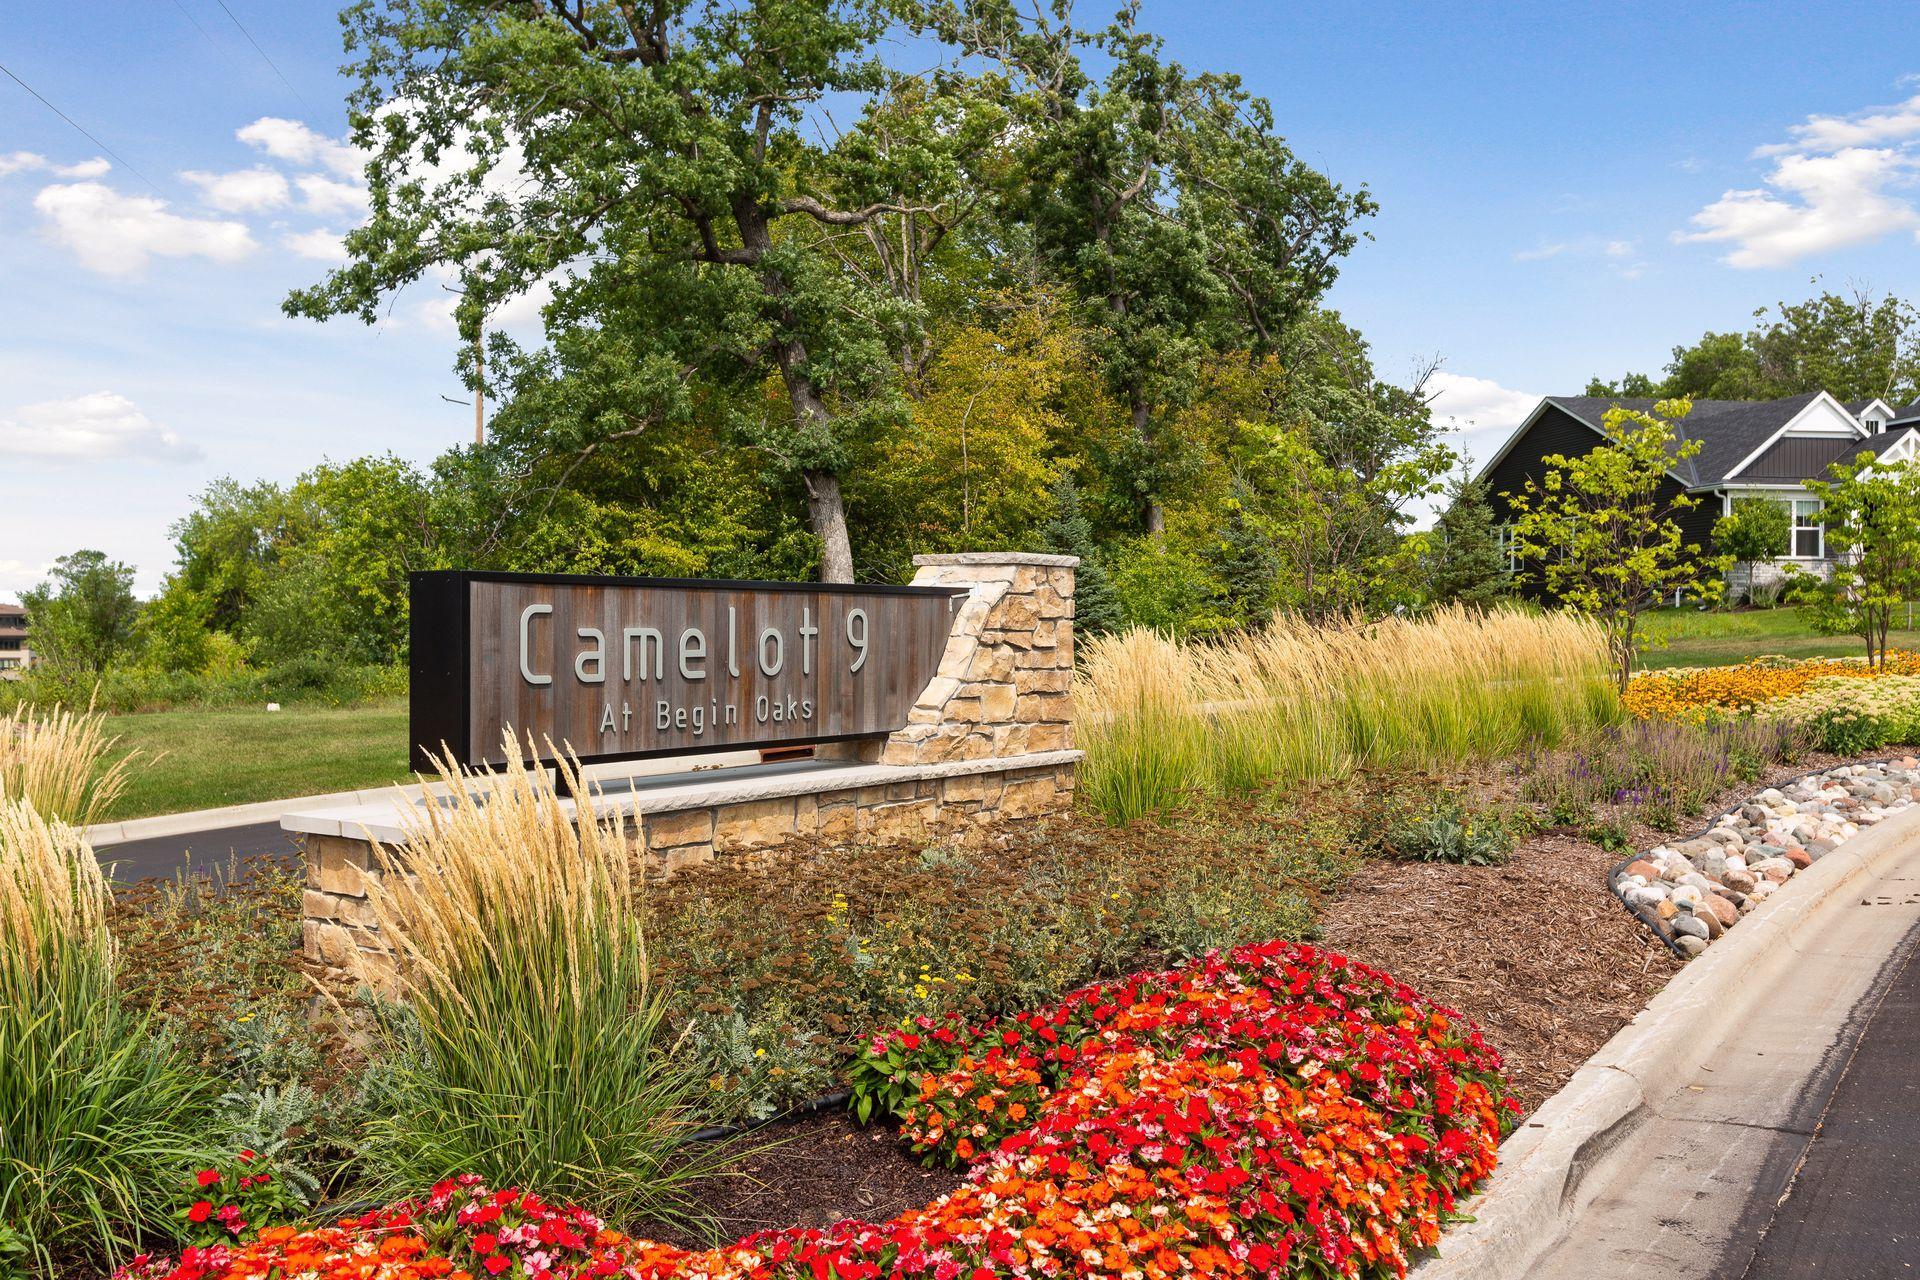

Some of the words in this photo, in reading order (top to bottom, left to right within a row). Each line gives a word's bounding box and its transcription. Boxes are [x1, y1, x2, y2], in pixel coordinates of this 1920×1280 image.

[519, 603, 818, 685] Camelot
[846, 607, 869, 673] 9
[600, 703, 632, 733] At
[656, 699, 737, 735] Begin
[756, 695, 812, 723] Oaks
